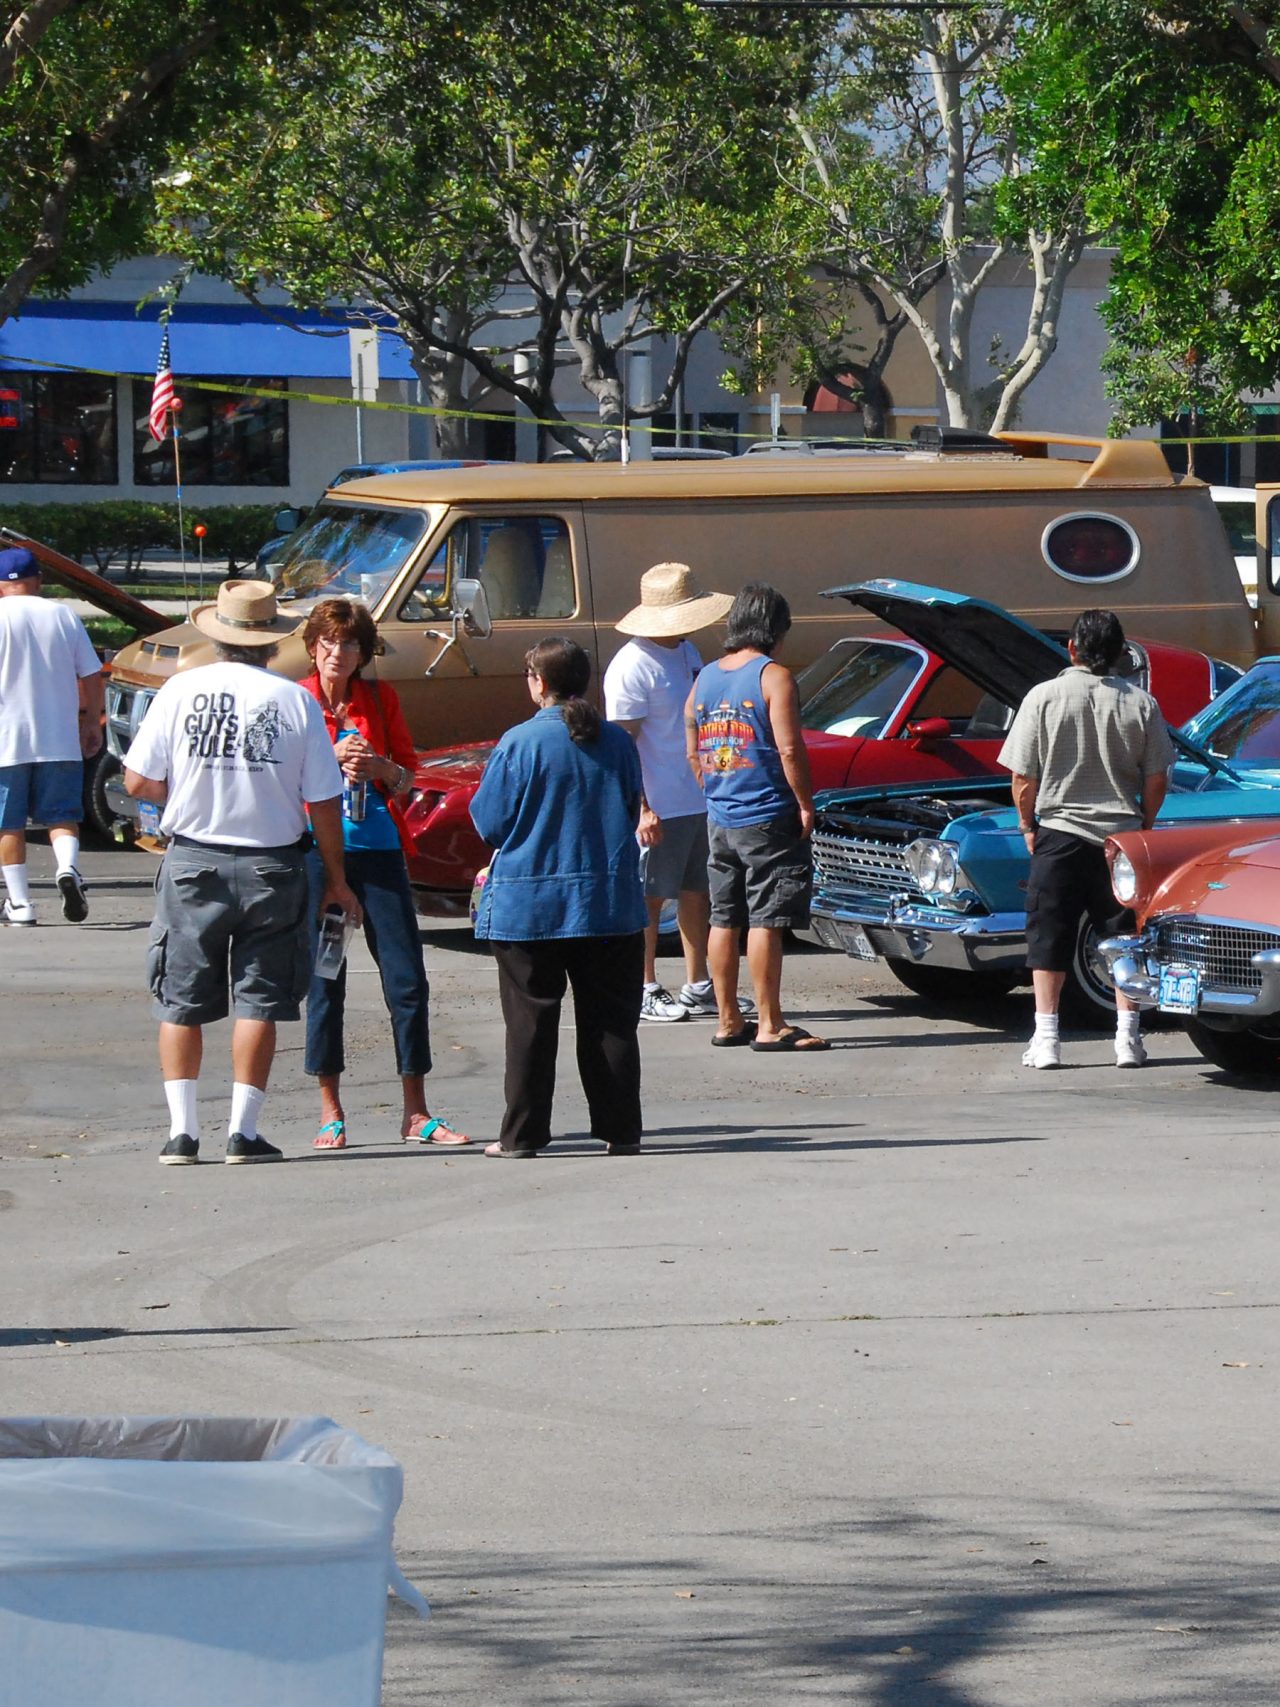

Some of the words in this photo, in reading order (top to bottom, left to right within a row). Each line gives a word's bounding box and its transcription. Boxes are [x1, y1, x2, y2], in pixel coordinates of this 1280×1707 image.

[193, 692, 235, 713] OLD
[184, 713, 238, 735] GUYS
[188, 735, 236, 758] RULE
